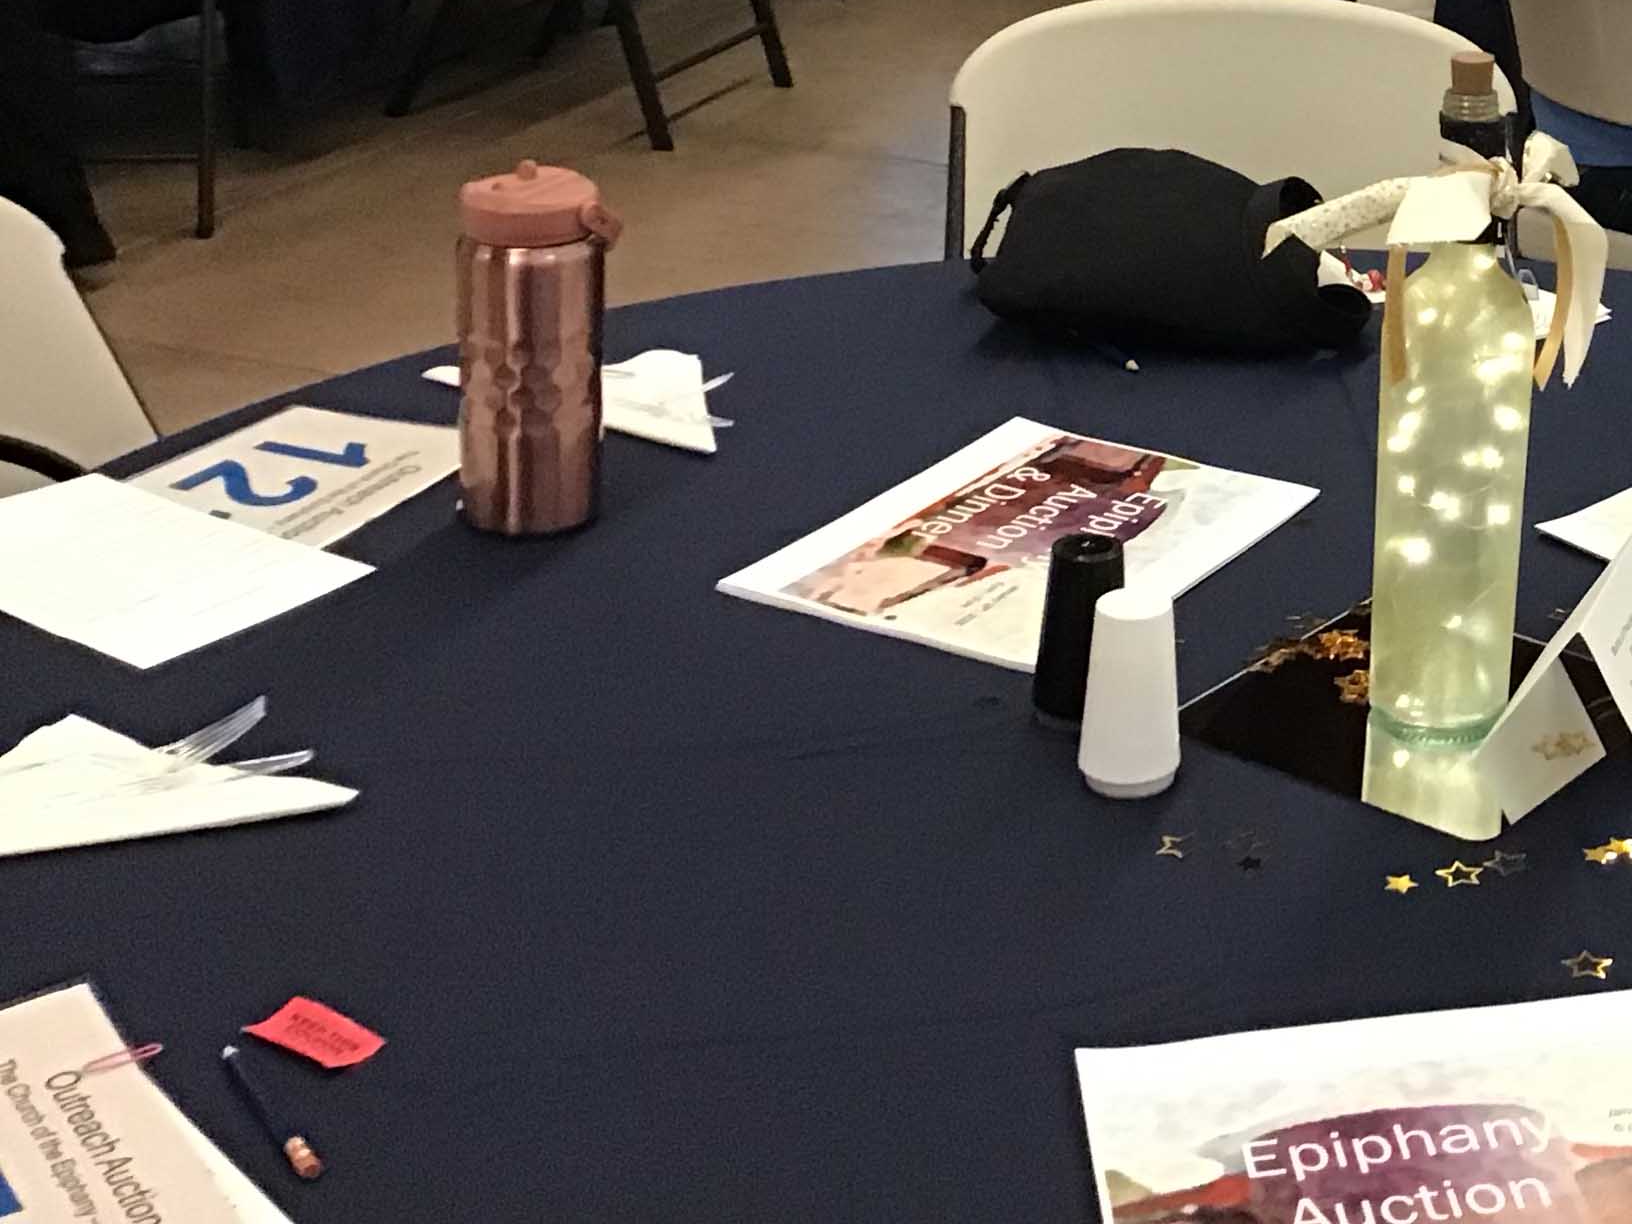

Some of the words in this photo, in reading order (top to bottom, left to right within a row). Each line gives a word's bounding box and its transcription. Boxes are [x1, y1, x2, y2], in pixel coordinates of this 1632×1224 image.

[168, 441, 370, 519] 12
[1007, 466, 1051, 484] &
[912, 484, 1026, 544] Dinner
[976, 483, 1098, 550] Auction
[6, 1083, 46, 1127] Church
[30, 1126, 58, 1141] of
[44, 1070, 121, 1159] Outreach
[38, 1137, 63, 1161] the
[1241, 1116, 1549, 1181] Epiphany
[51, 1157, 97, 1218] Epiphany
[1293, 1177, 1553, 1224] Auction
